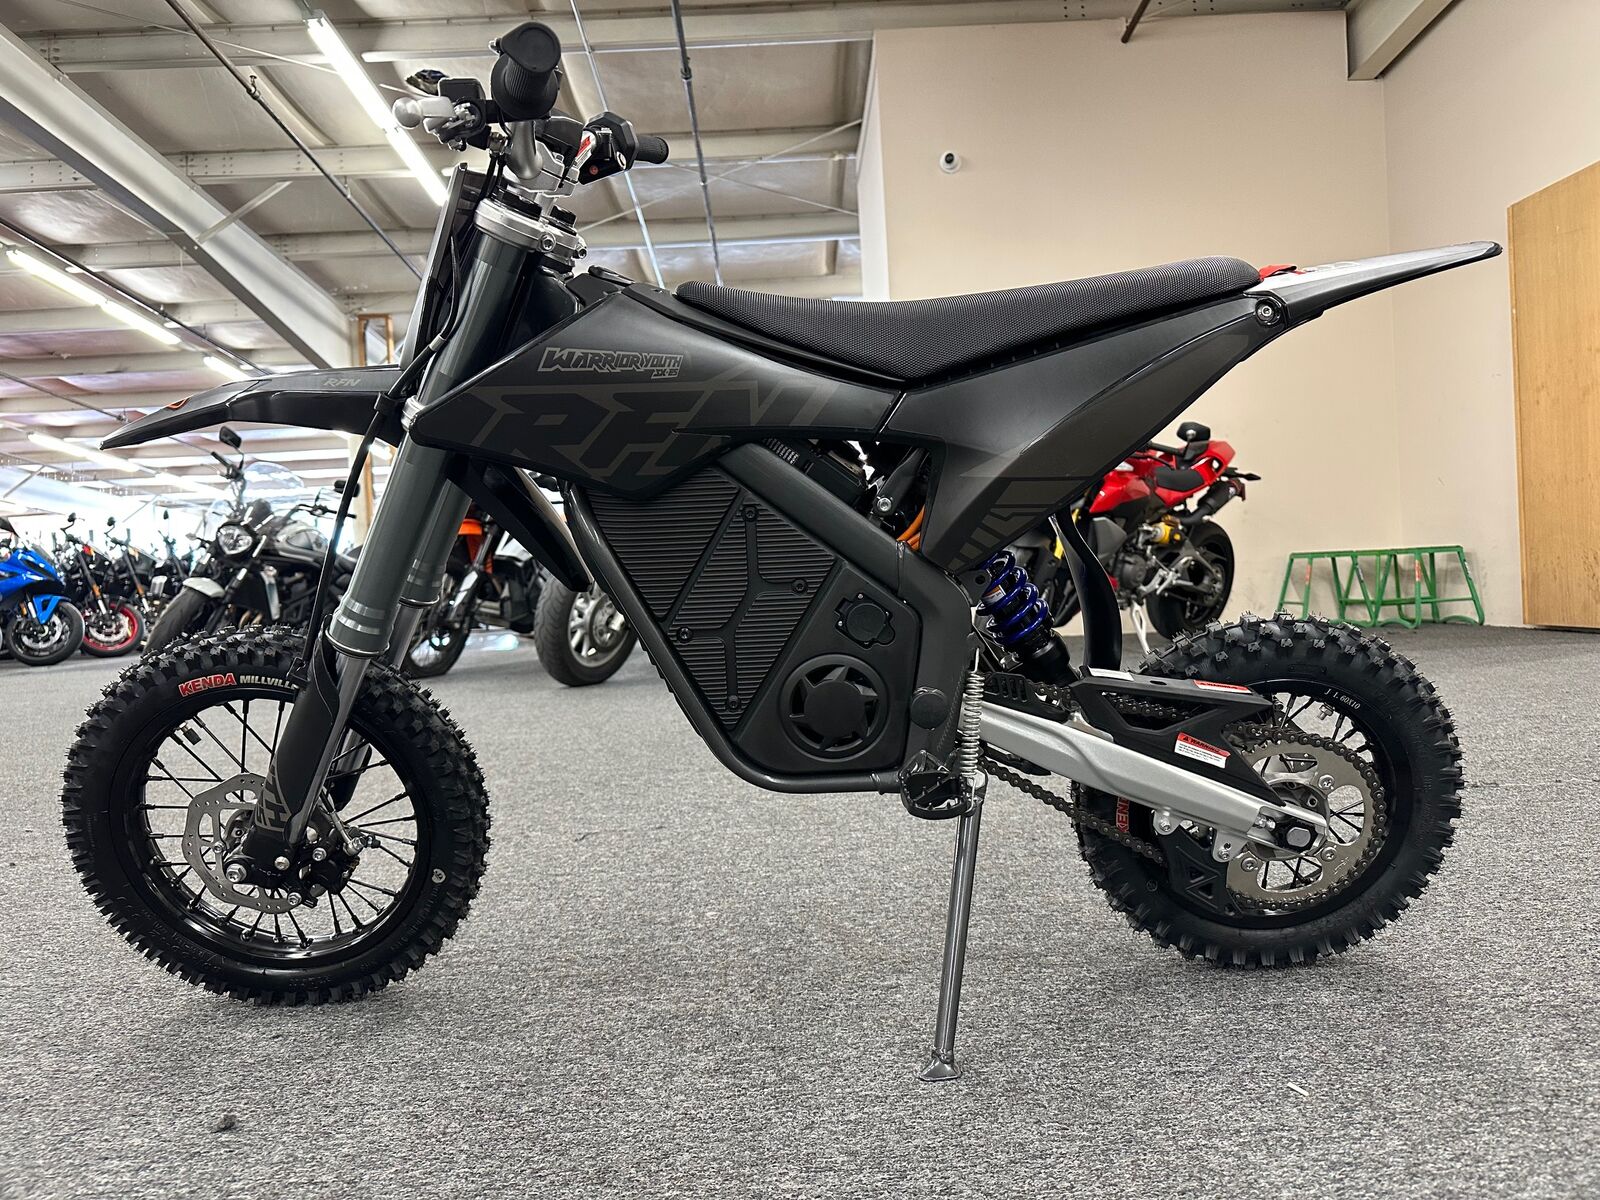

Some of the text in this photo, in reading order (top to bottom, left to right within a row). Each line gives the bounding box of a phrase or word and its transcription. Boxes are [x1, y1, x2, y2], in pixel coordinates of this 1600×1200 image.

[538, 347, 683, 373] WARRIOR YOUTH
[323, 377, 361, 387] RFN
[179, 672, 237, 697] KENDA
[1116, 796, 1130, 833] KEN
